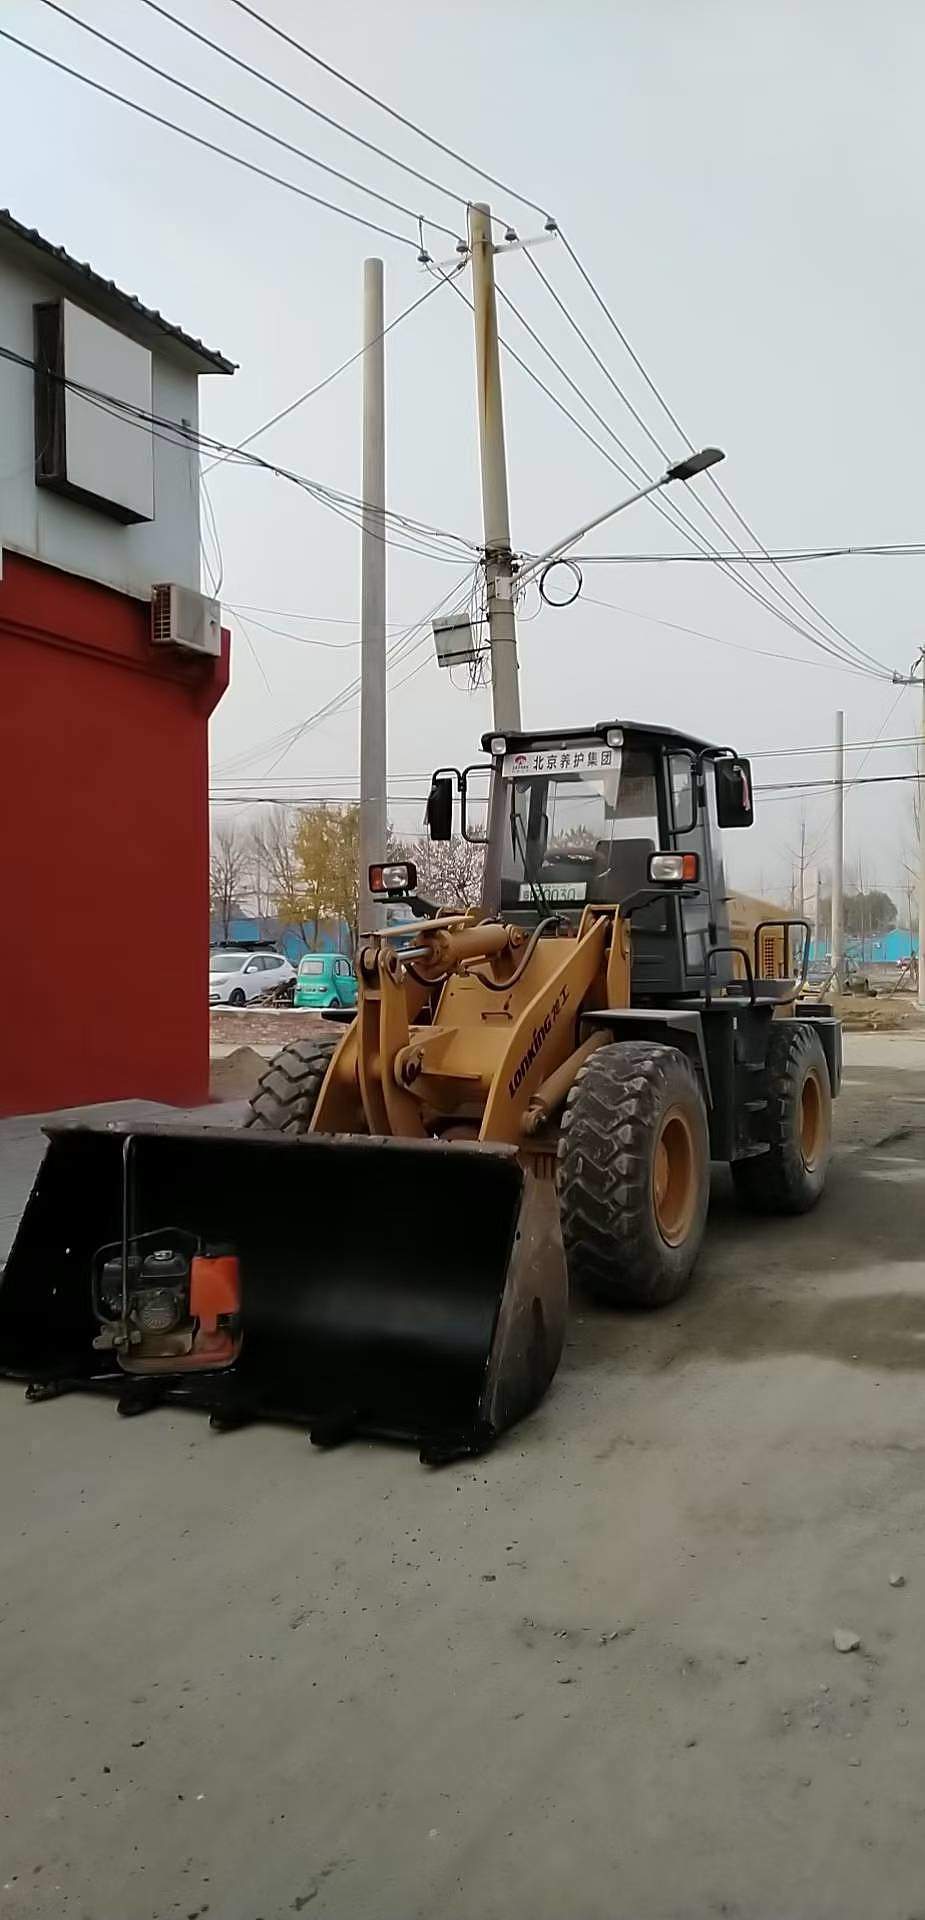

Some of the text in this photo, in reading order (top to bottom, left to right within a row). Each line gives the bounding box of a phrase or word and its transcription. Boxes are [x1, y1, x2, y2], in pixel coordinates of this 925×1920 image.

[533, 750, 612, 771] 北京养护集团
